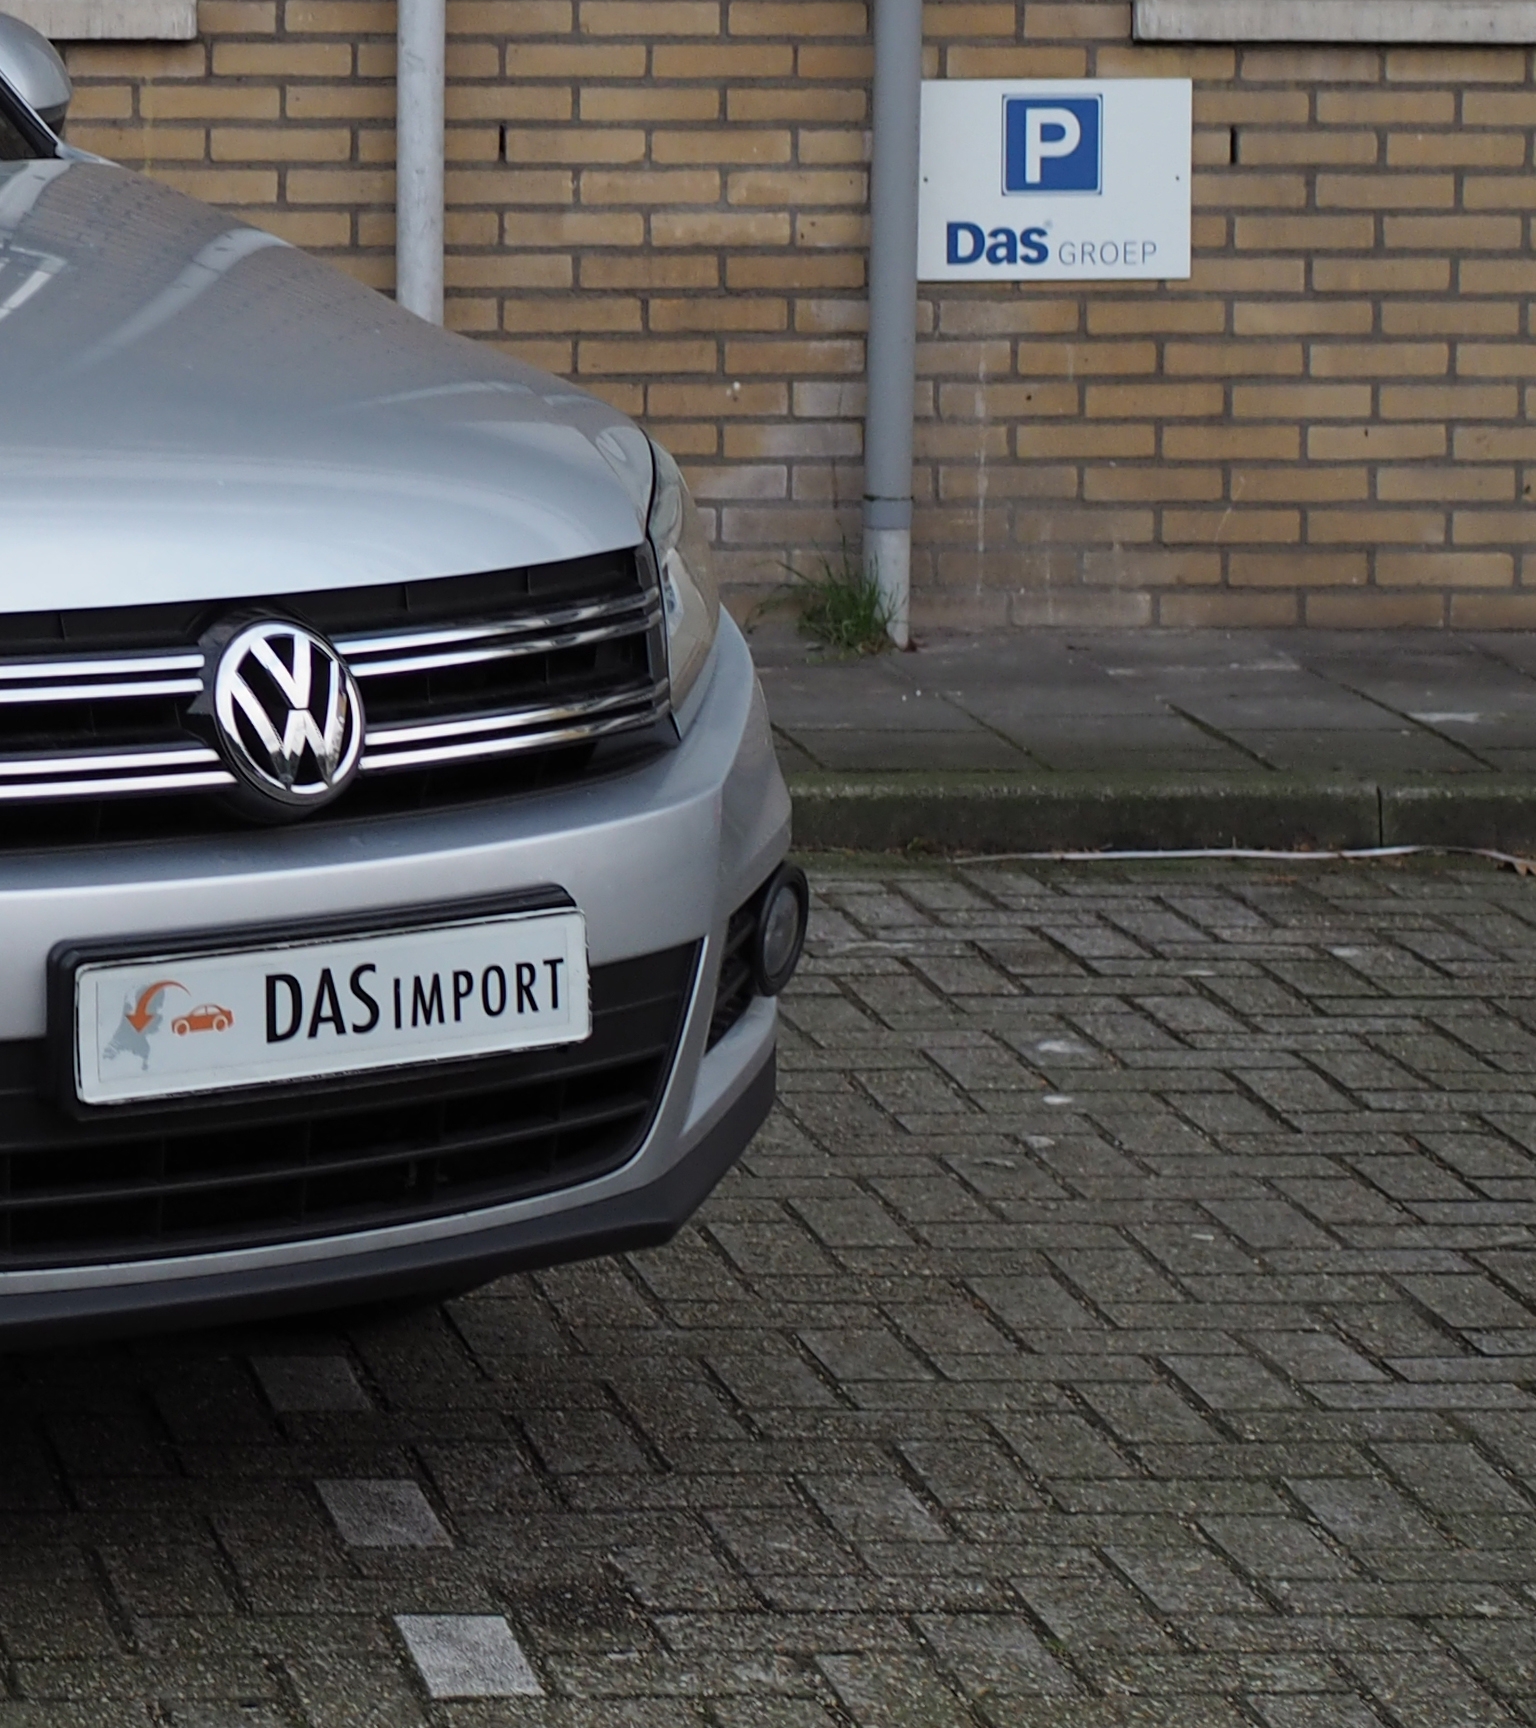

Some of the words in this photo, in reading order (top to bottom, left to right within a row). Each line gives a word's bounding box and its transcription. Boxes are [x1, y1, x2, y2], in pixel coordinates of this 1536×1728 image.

[1025, 106, 1081, 185] P
[946, 221, 1050, 266] Das
[1058, 241, 1158, 266] GROEP
[393, 957, 565, 1030] IMPORT
